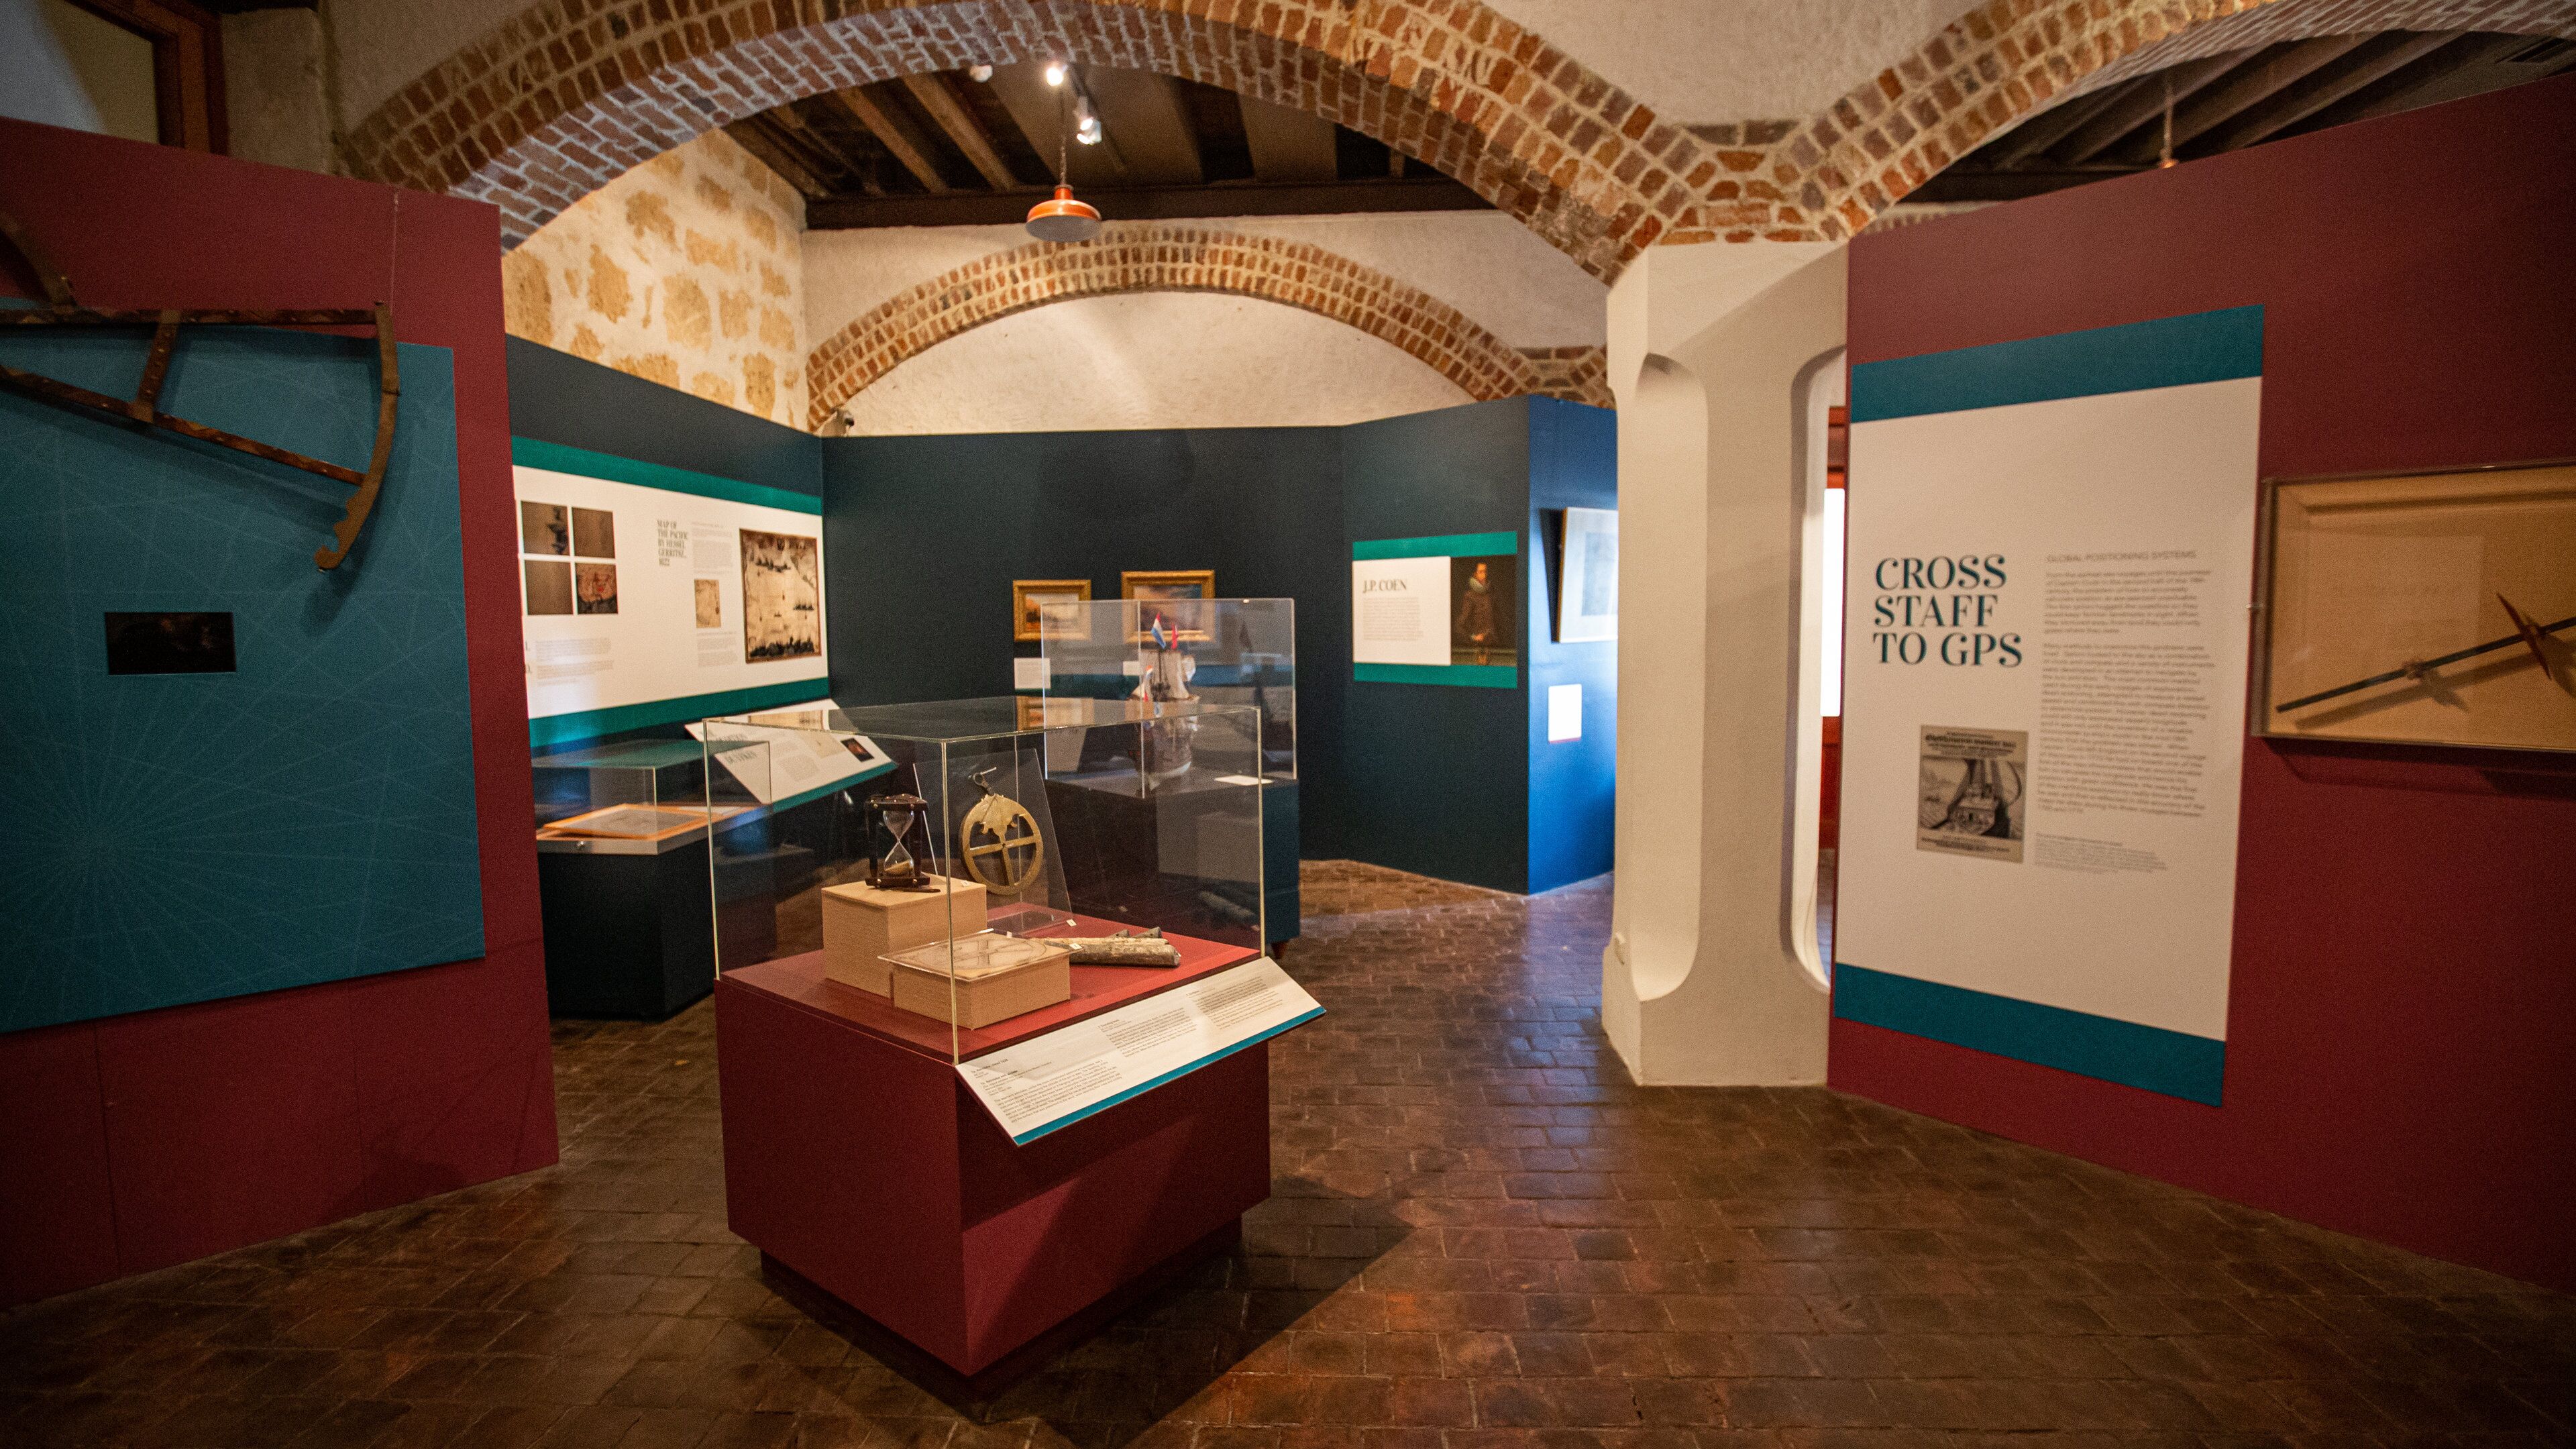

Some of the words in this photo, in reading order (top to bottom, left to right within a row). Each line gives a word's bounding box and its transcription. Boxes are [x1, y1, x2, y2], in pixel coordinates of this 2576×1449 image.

[657, 519, 669, 529] MAP
[657, 529, 668, 538] THE
[2046, 553, 2082, 563] GLOBAL
[2085, 551, 2149, 561] POSITIONING
[2151, 549, 2197, 559] SYSTEMS
[1876, 554, 2007, 590] CROSS
[1362, 579, 1377, 594] J.P.
[1379, 579, 1407, 591] COEN
[1874, 594, 1998, 628] STAFF
[1873, 632, 1927, 665] TO
[1941, 632, 2022, 668] GPS
